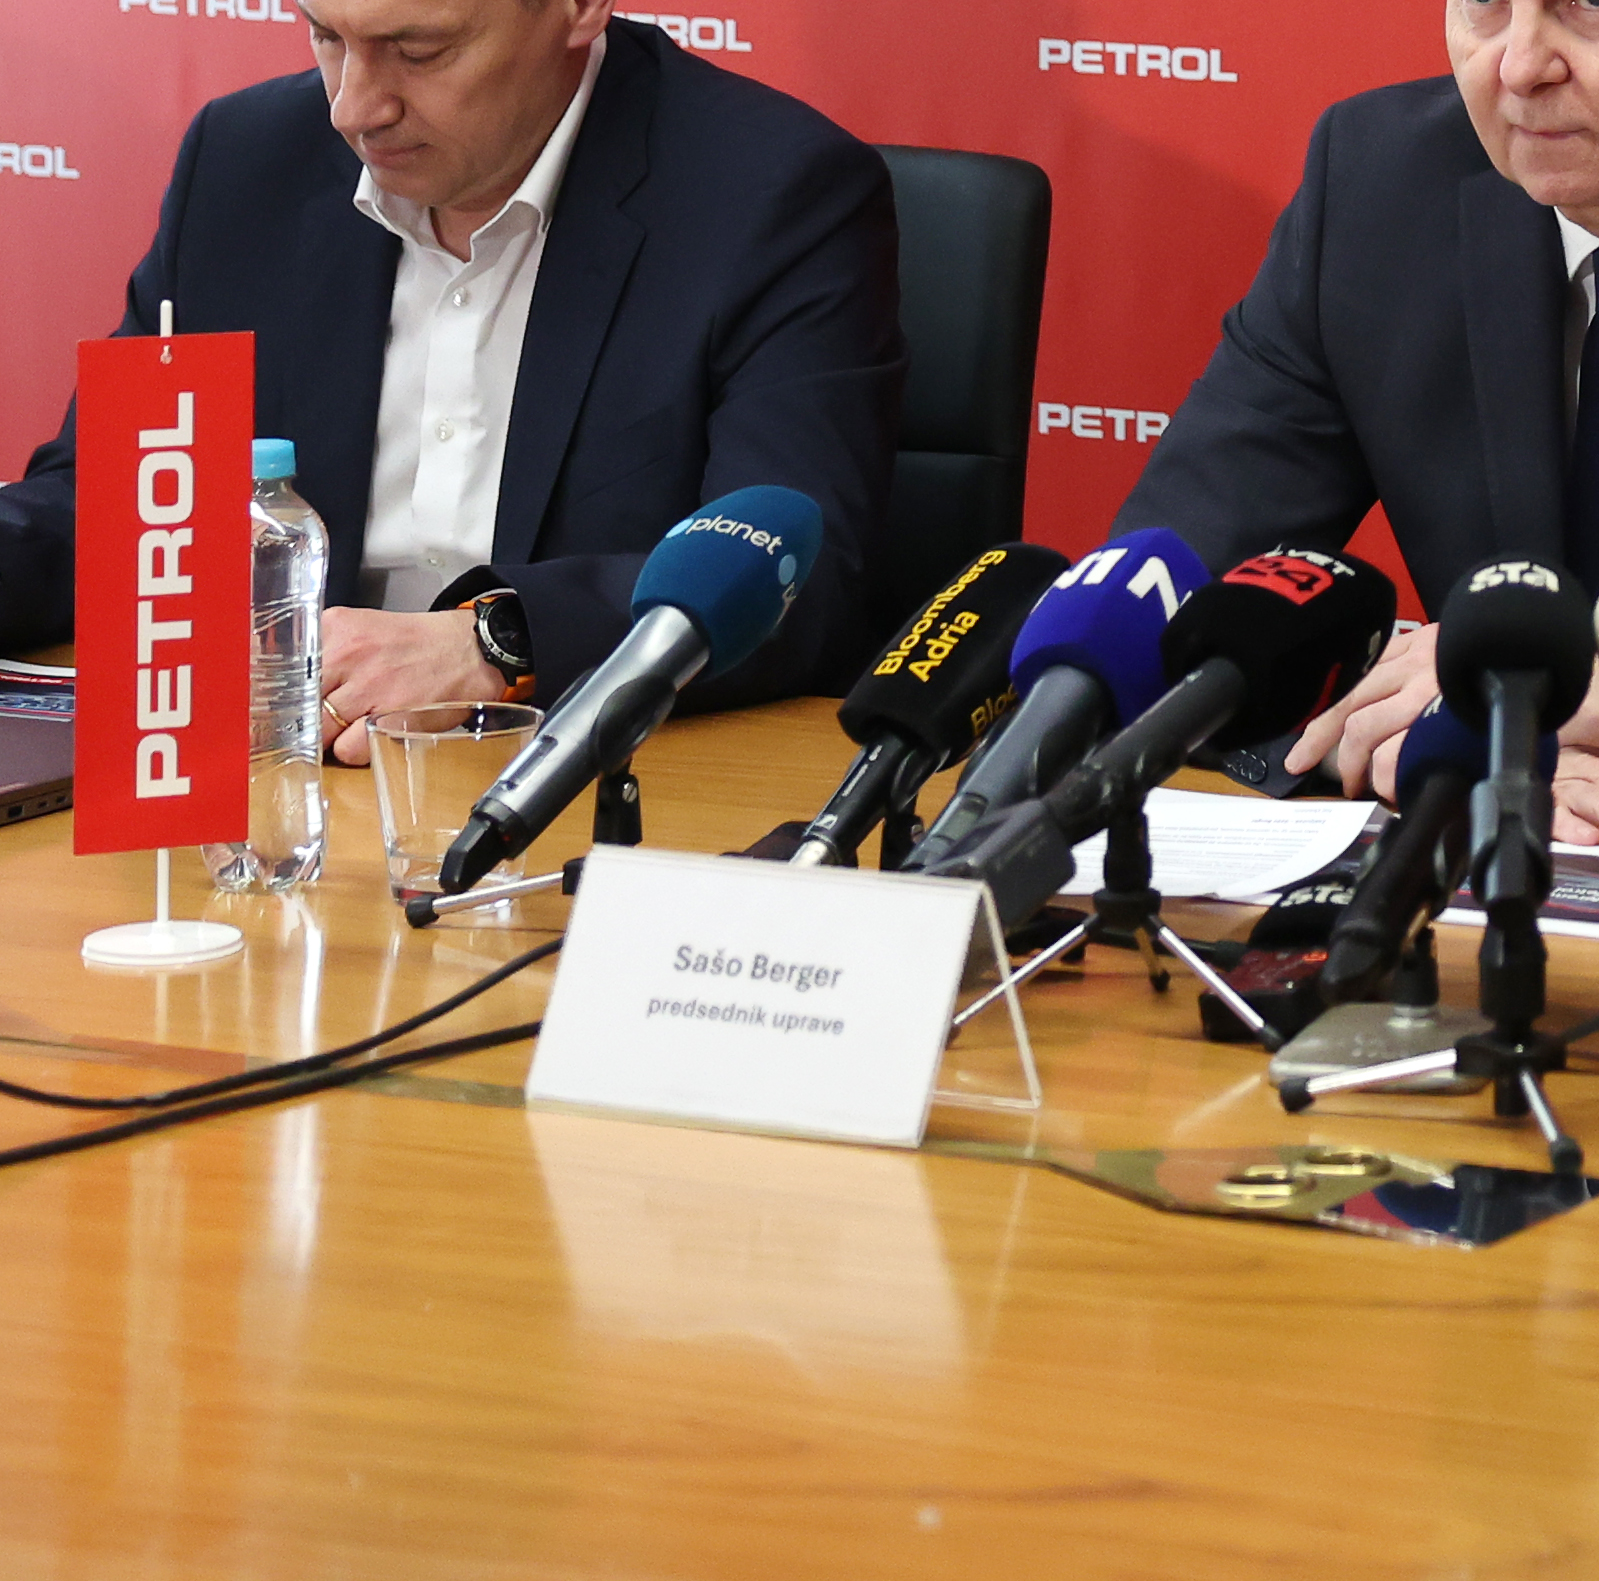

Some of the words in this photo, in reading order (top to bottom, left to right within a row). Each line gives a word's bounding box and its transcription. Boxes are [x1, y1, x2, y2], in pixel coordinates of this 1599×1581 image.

[612, 12, 752, 52] ROL
[1039, 39, 1237, 82] PETROL
[0, 143, 79, 178] ROL
[1039, 403, 1170, 442] PETR
[685, 514, 783, 556] planet
[136, 392, 193, 798] PETROL
[873, 549, 1007, 676] Bloomberg
[908, 610, 980, 683] Adria
[674, 944, 743, 977] Sašo
[750, 953, 843, 993] Berger
[647, 997, 767, 1027] predsednik
[772, 1012, 845, 1035] uprave
